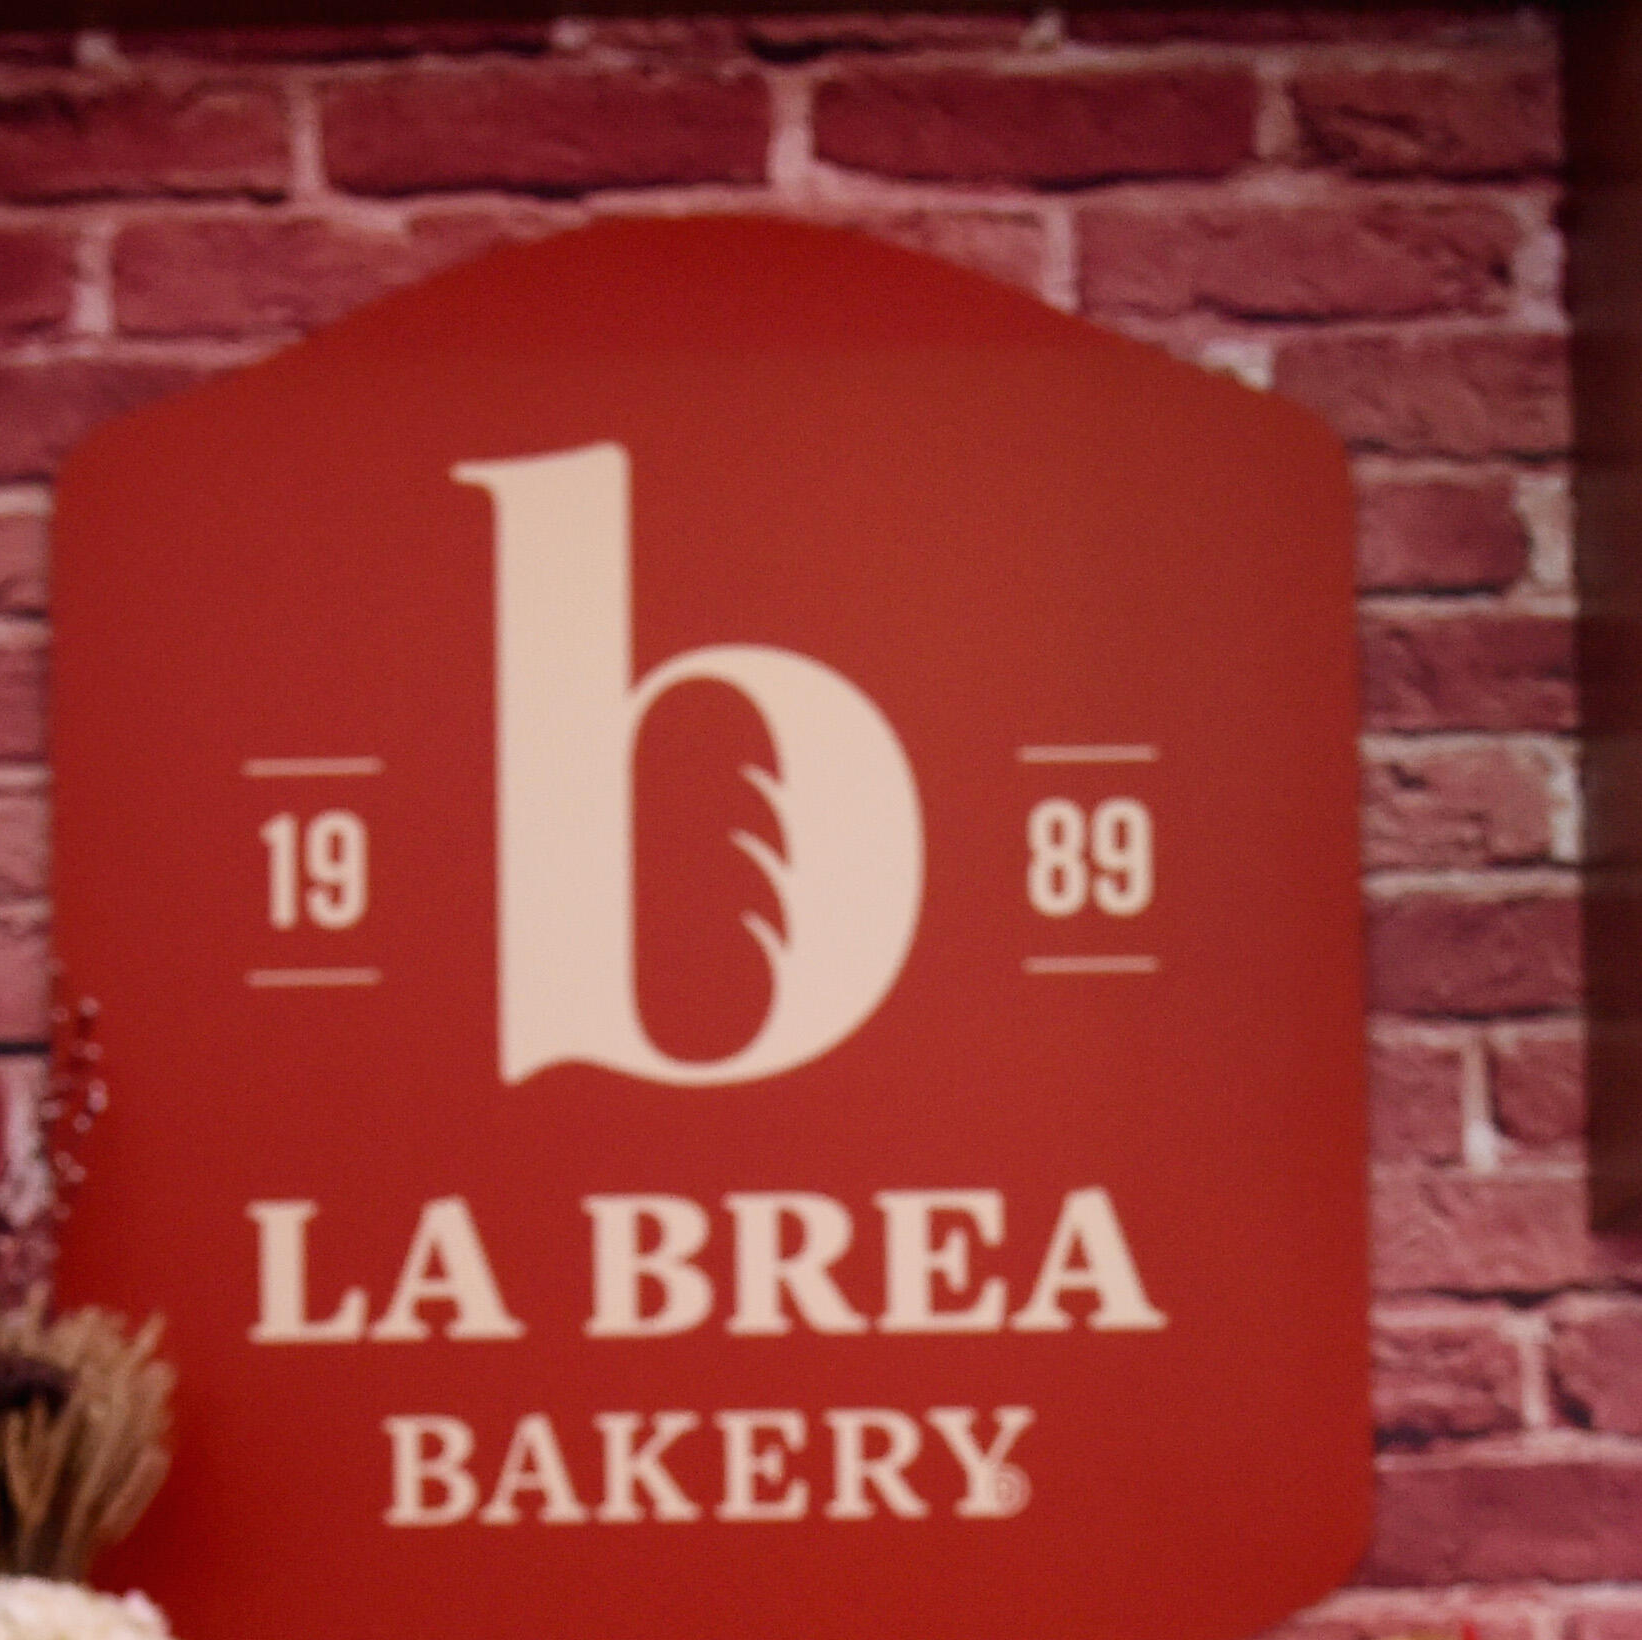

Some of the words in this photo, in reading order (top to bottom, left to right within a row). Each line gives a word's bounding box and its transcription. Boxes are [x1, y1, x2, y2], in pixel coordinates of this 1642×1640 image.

[451, 442, 926, 1087] b
[260, 809, 369, 930] 19
[1025, 796, 1155, 918] 89
[246, 1196, 525, 1344] LA
[581, 1185, 1169, 1339] BREA
[382, 1403, 1036, 1528] BAKERY
